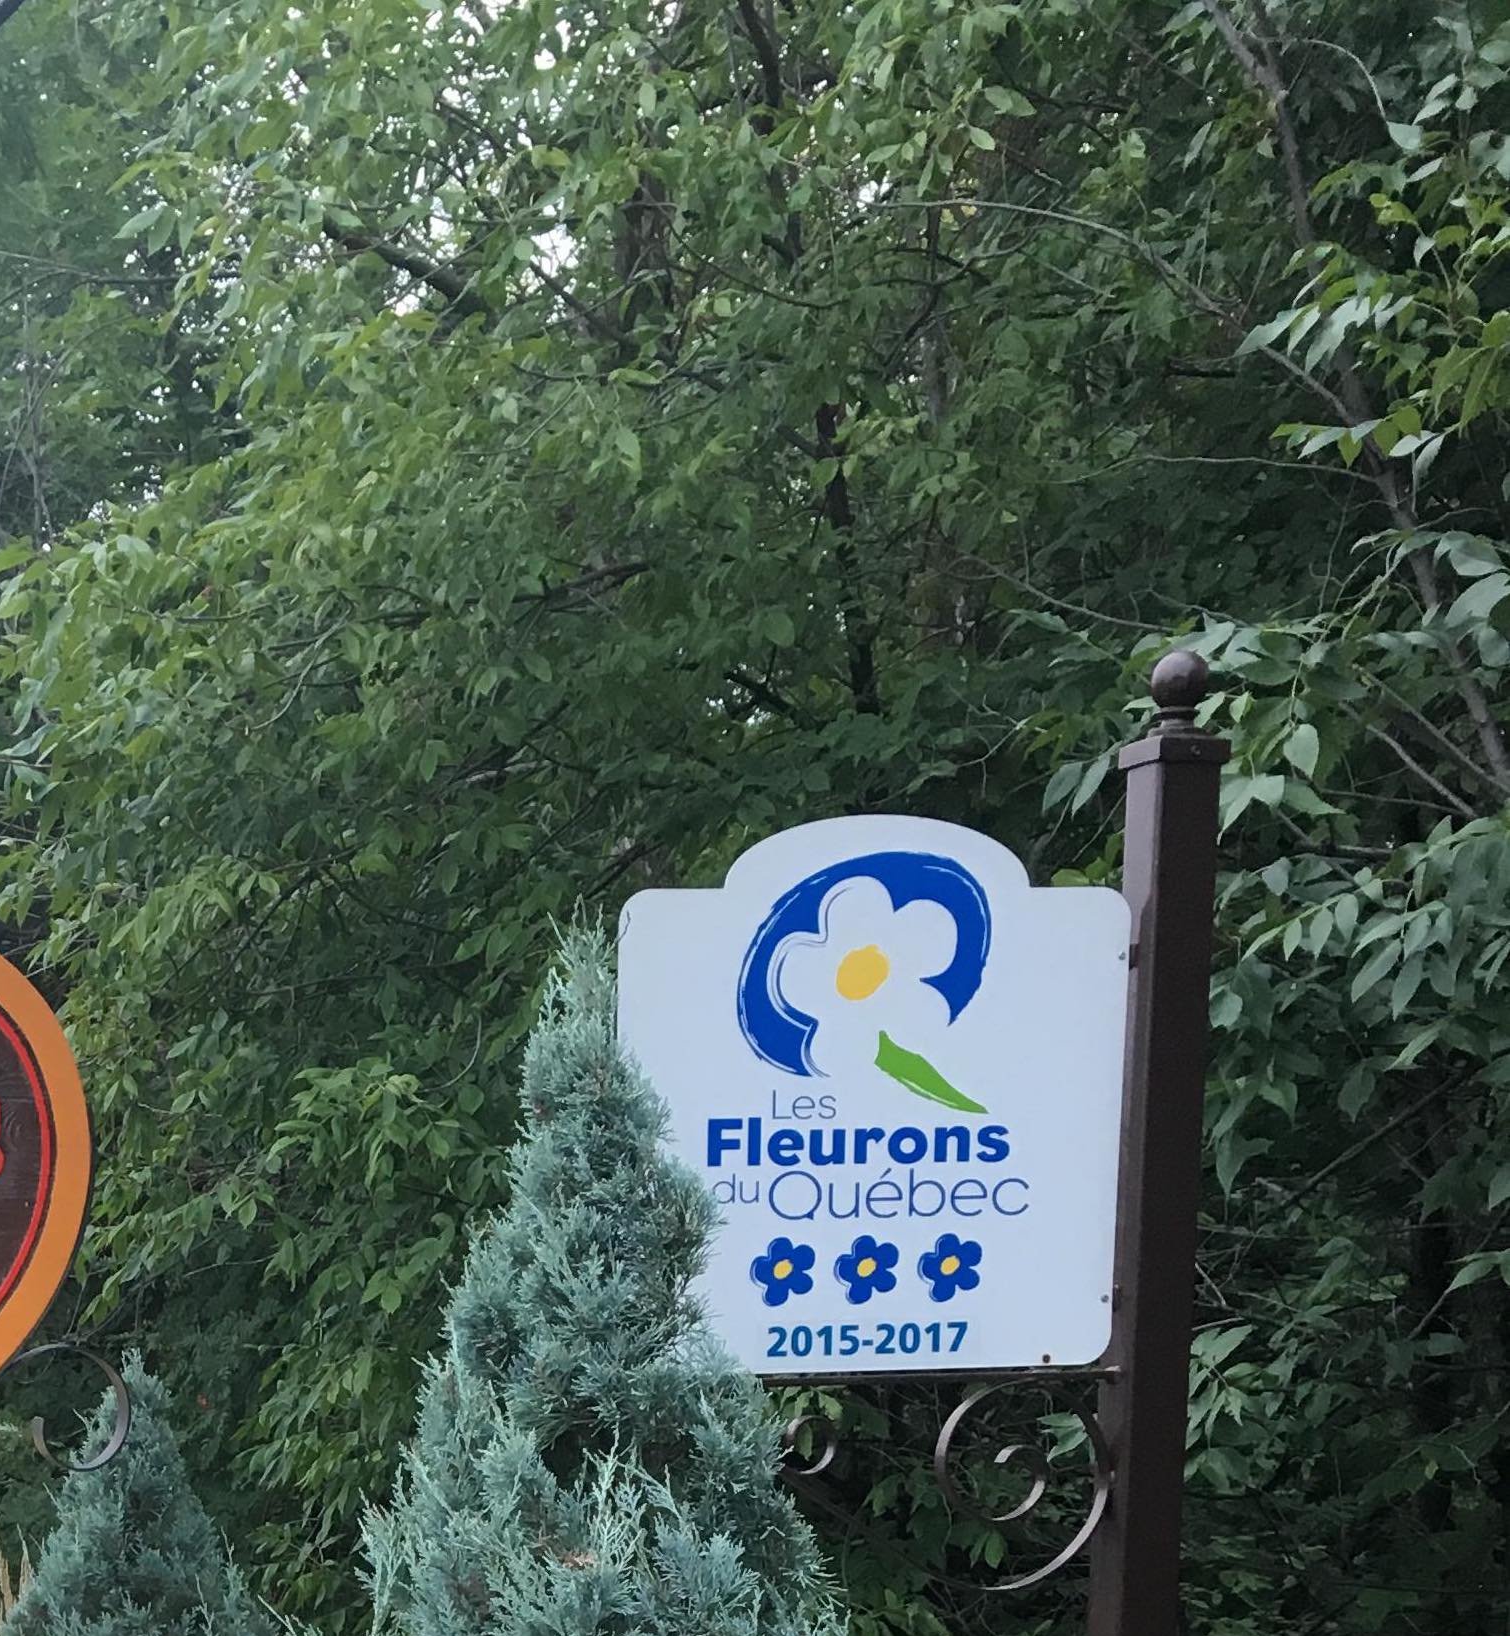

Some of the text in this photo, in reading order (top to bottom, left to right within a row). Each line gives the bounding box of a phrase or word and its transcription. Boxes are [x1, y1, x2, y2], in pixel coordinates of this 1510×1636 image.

[771, 1089, 837, 1120] Les
[706, 1117, 1011, 1168] Fleurons
[712, 1168, 1031, 1221] du Québec
[766, 1321, 969, 1358] 2015-2017
